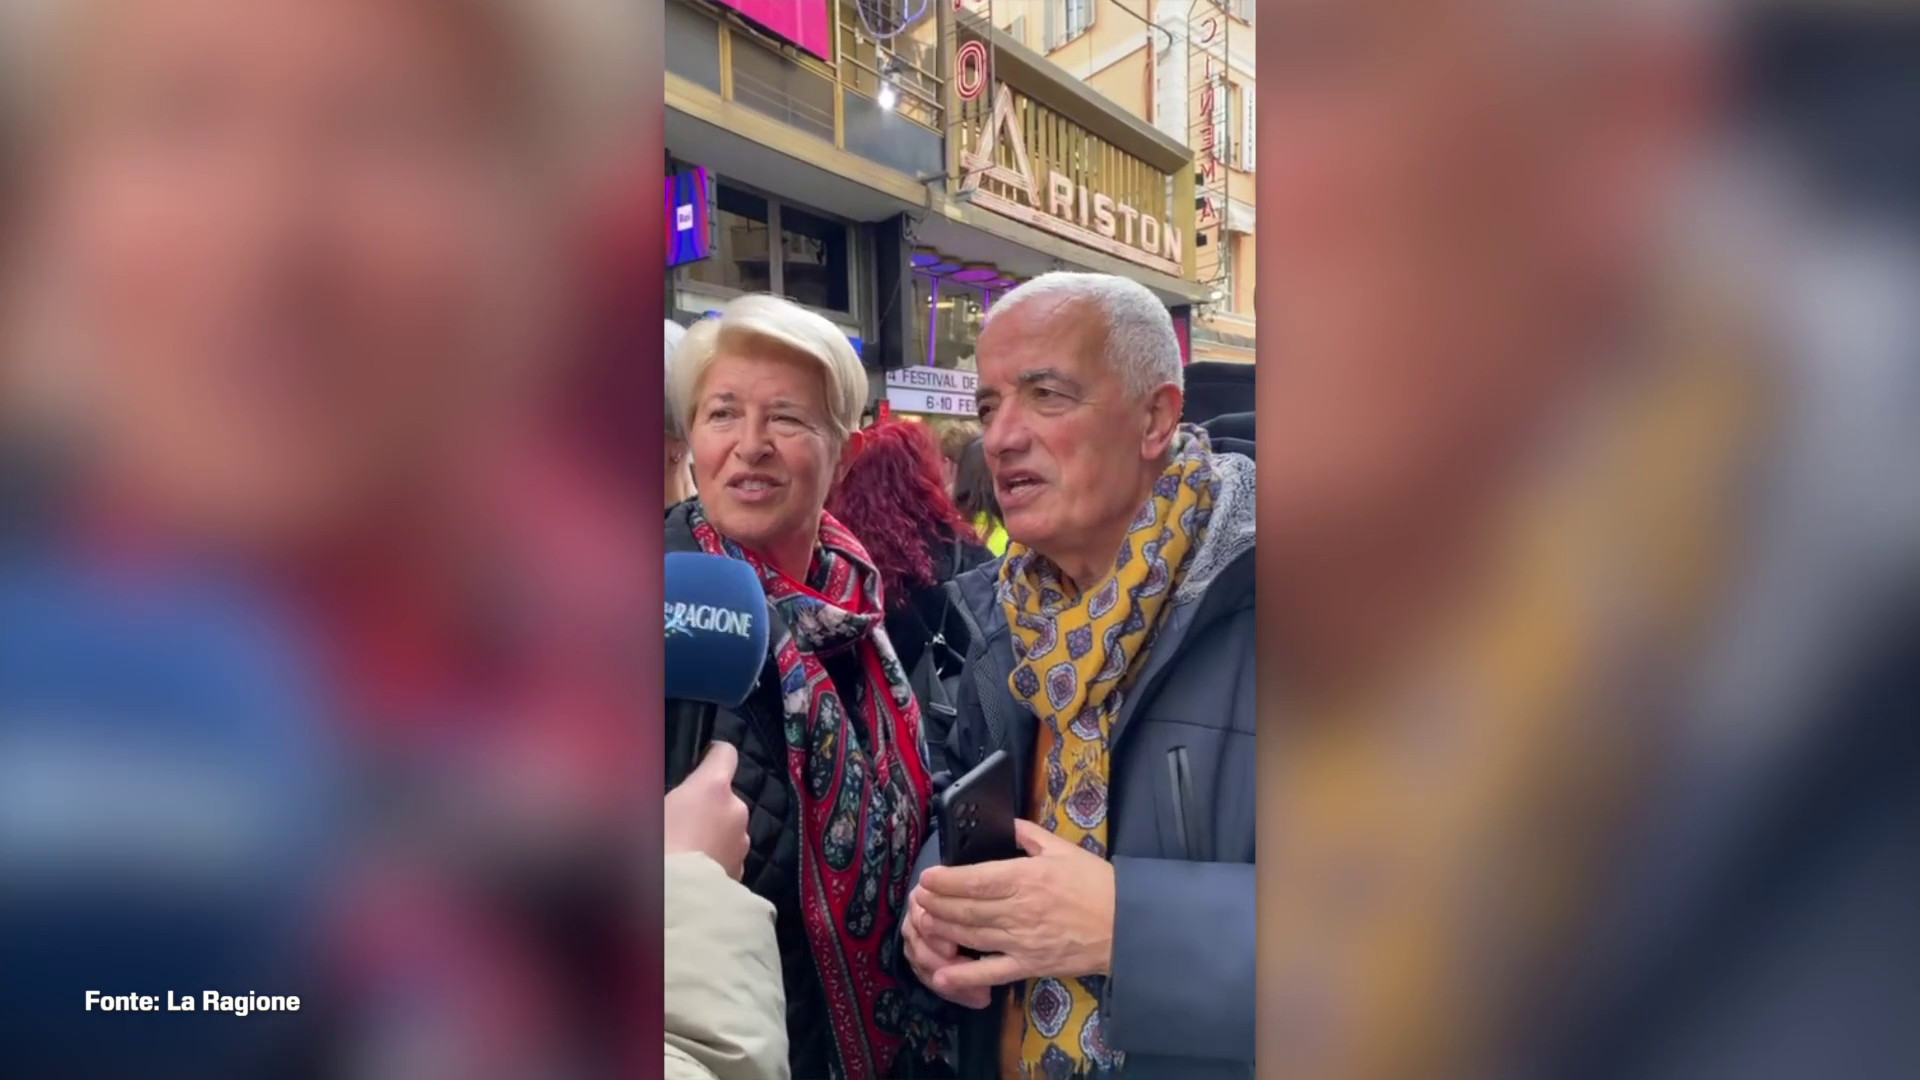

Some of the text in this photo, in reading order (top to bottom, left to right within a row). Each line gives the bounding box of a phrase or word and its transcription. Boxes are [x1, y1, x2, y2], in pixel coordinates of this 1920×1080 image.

[960, 82, 1183, 264] ARISTON
[902, 370, 957, 389] FESTIVAL
[958, 398, 977, 413] FE
[675, 602, 753, 639] RAGIONE
